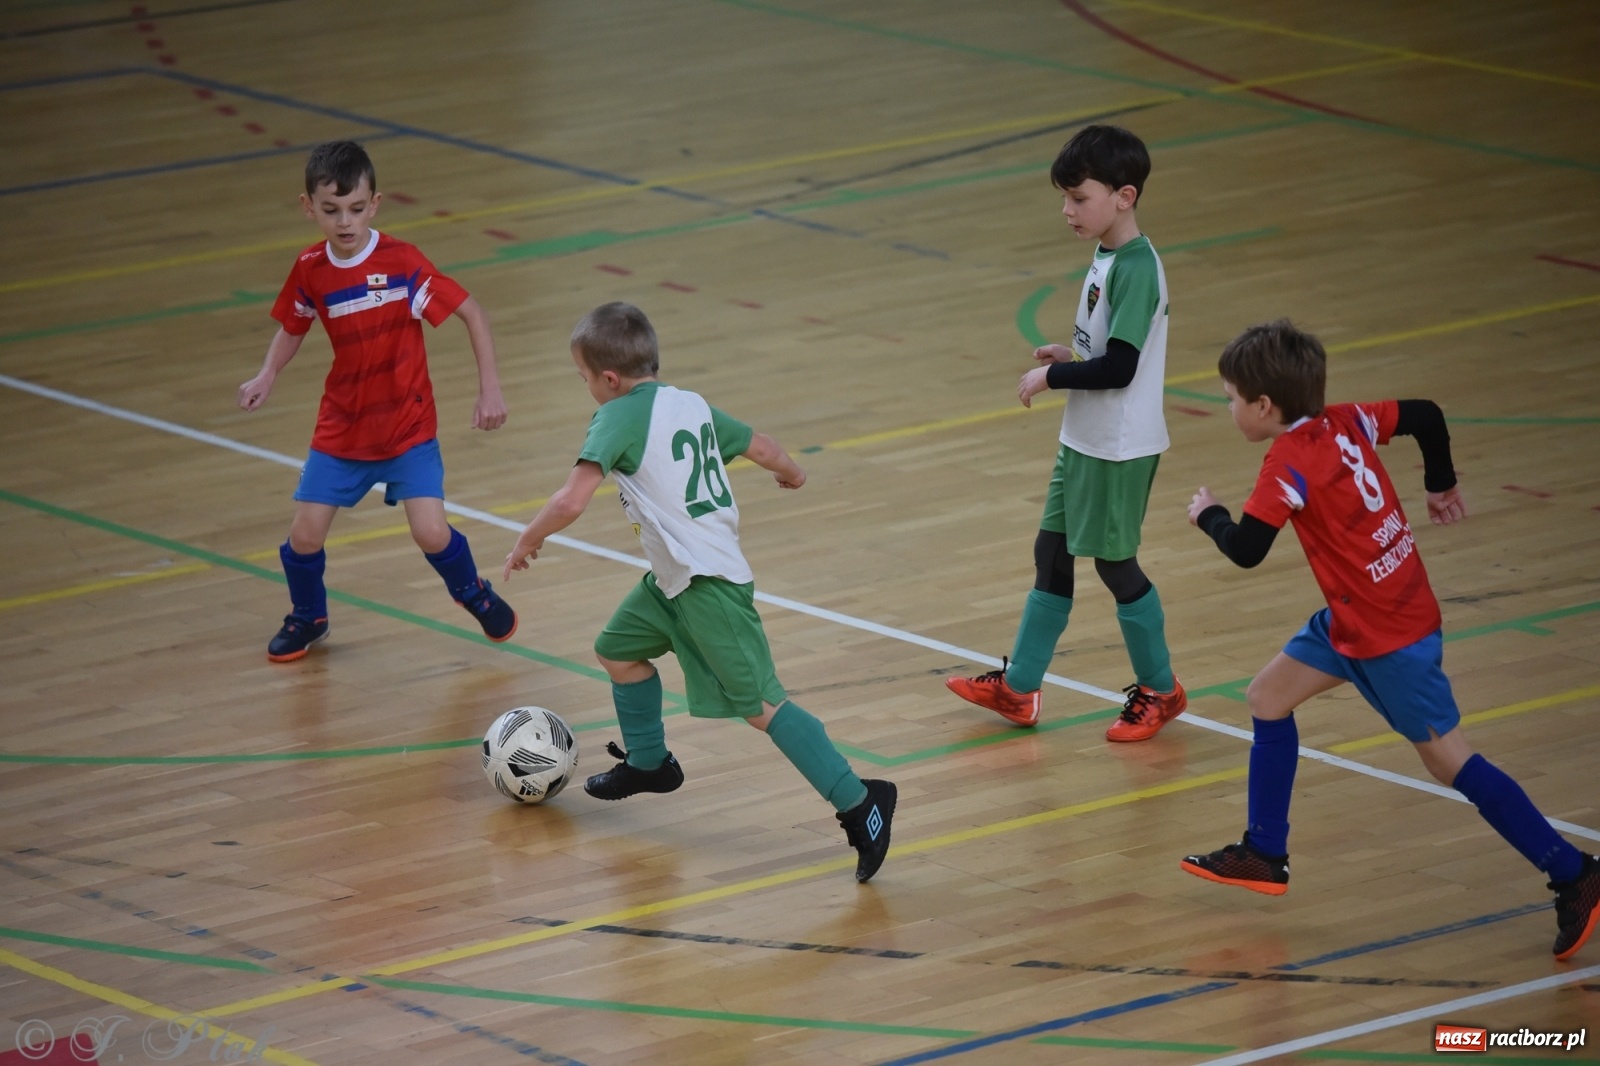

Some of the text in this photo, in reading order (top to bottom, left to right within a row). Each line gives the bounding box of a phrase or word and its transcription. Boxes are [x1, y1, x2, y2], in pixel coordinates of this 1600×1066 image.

[374, 291, 383, 303] S
[671, 422, 733, 519] 26
[1334, 432, 1385, 513] 8
